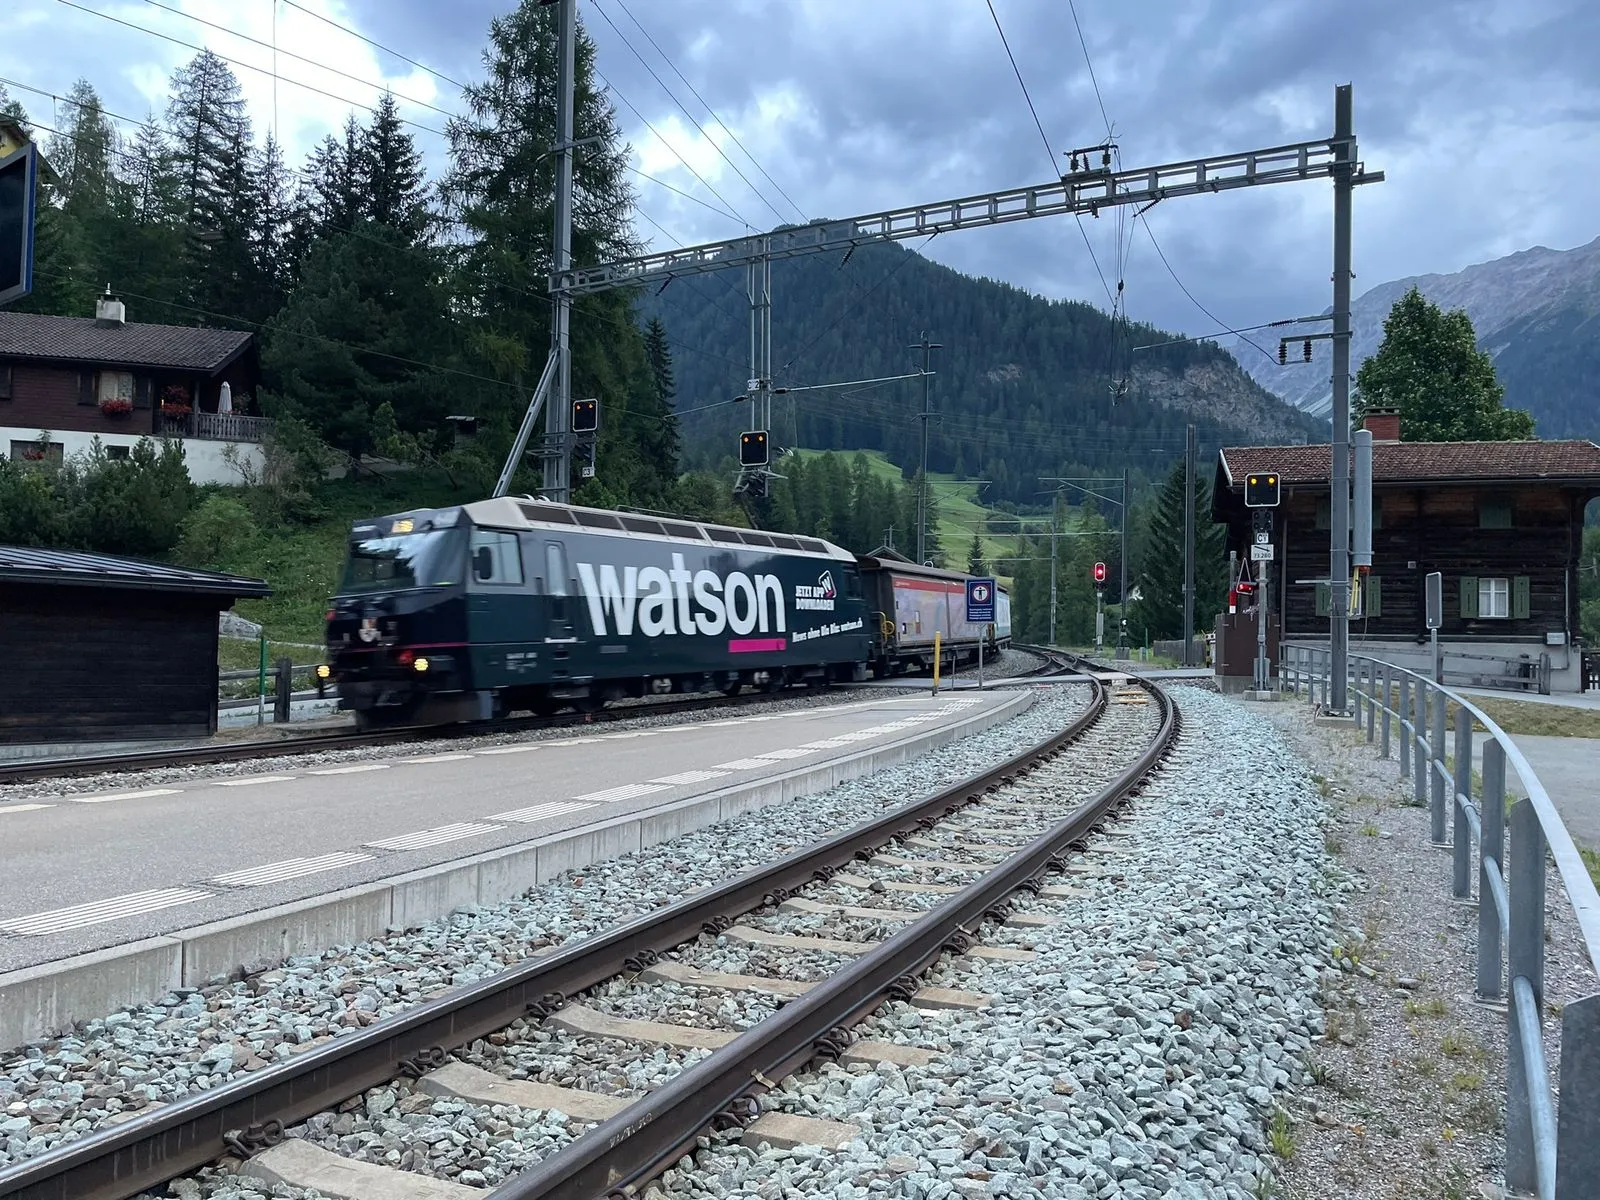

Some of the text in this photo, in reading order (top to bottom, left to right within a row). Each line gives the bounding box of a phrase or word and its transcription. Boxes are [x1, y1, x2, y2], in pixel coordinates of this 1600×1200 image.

[576, 552, 787, 637] watson
[795, 585, 825, 598] JETZT APP
[795, 598, 835, 611] DOWNLOADEN
